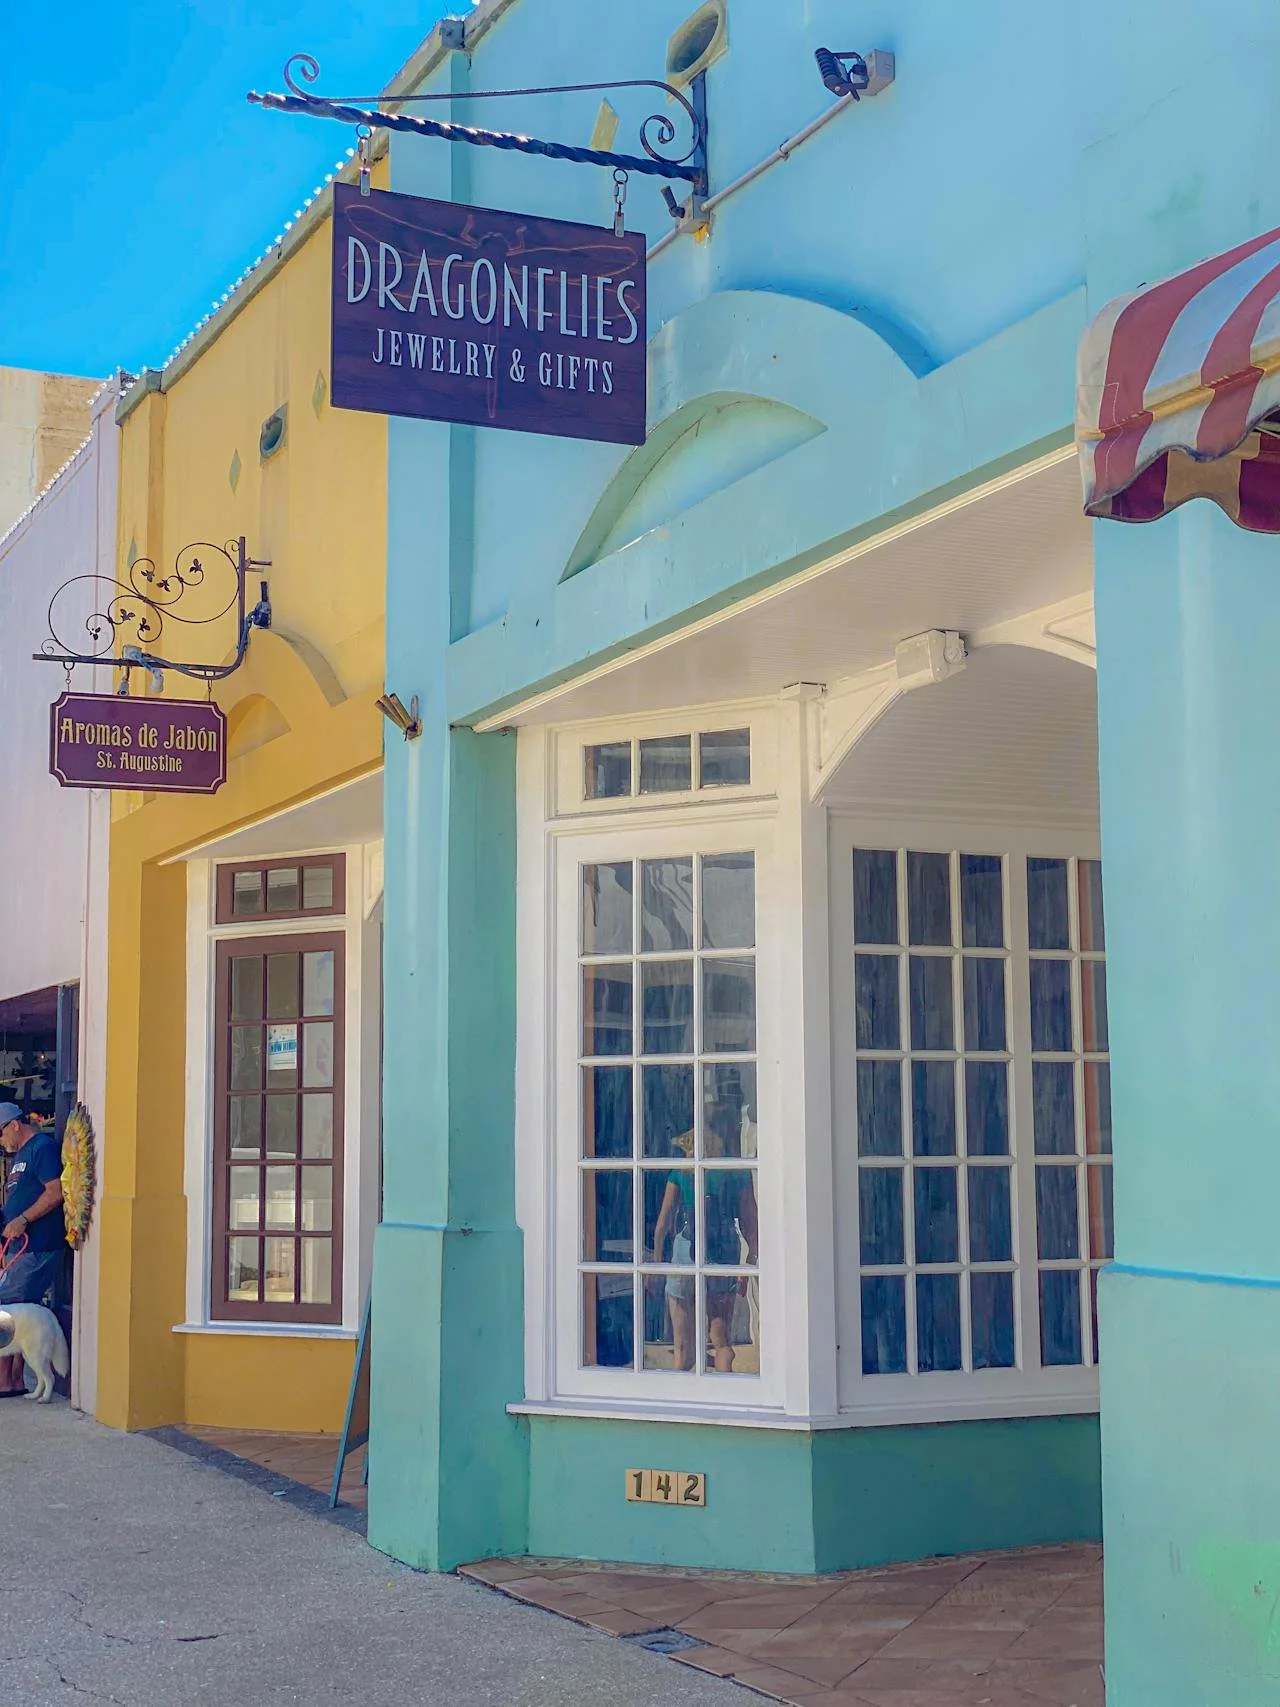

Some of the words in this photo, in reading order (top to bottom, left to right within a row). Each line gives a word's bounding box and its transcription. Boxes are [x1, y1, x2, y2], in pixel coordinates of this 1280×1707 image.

[347, 236, 639, 344] DRAGONFLIES
[372, 328, 497, 380] JEWELRY
[509, 348, 526, 383] &
[538, 351, 614, 395] GIFTS
[60, 717, 132, 747] Aromas
[138, 723, 158, 749] de
[163, 724, 217, 752] Jabón
[96, 750, 116, 769] St.
[119, 752, 183, 773] Augustine
[632, 1471, 701, 1502] 142
